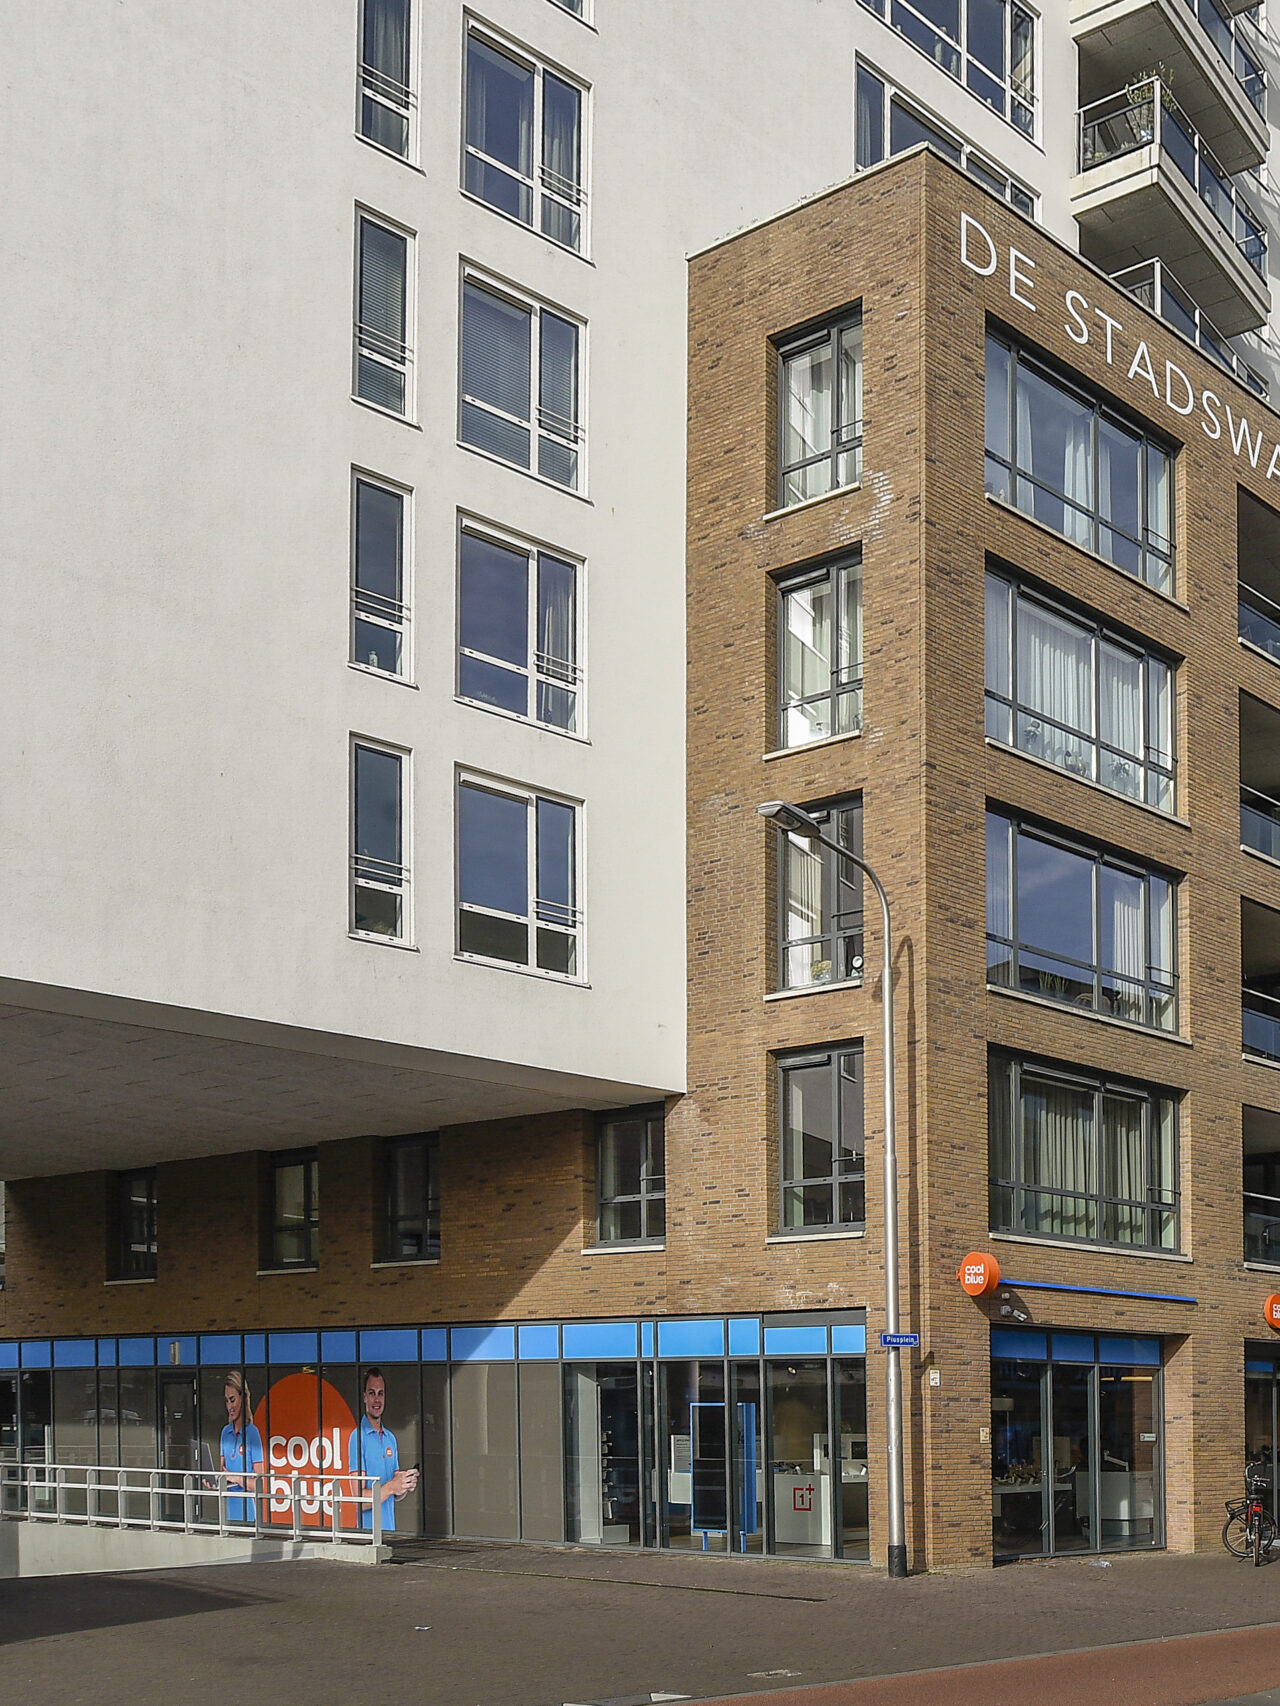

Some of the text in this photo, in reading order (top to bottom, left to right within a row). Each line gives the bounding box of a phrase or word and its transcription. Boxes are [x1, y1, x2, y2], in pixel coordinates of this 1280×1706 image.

[960, 211, 1037, 313] DE
[965, 1264, 984, 1274] cool
[965, 1274, 984, 1284] blue
[886, 1335, 915, 1344] Piusplein
[270, 1427, 342, 1470] cool
